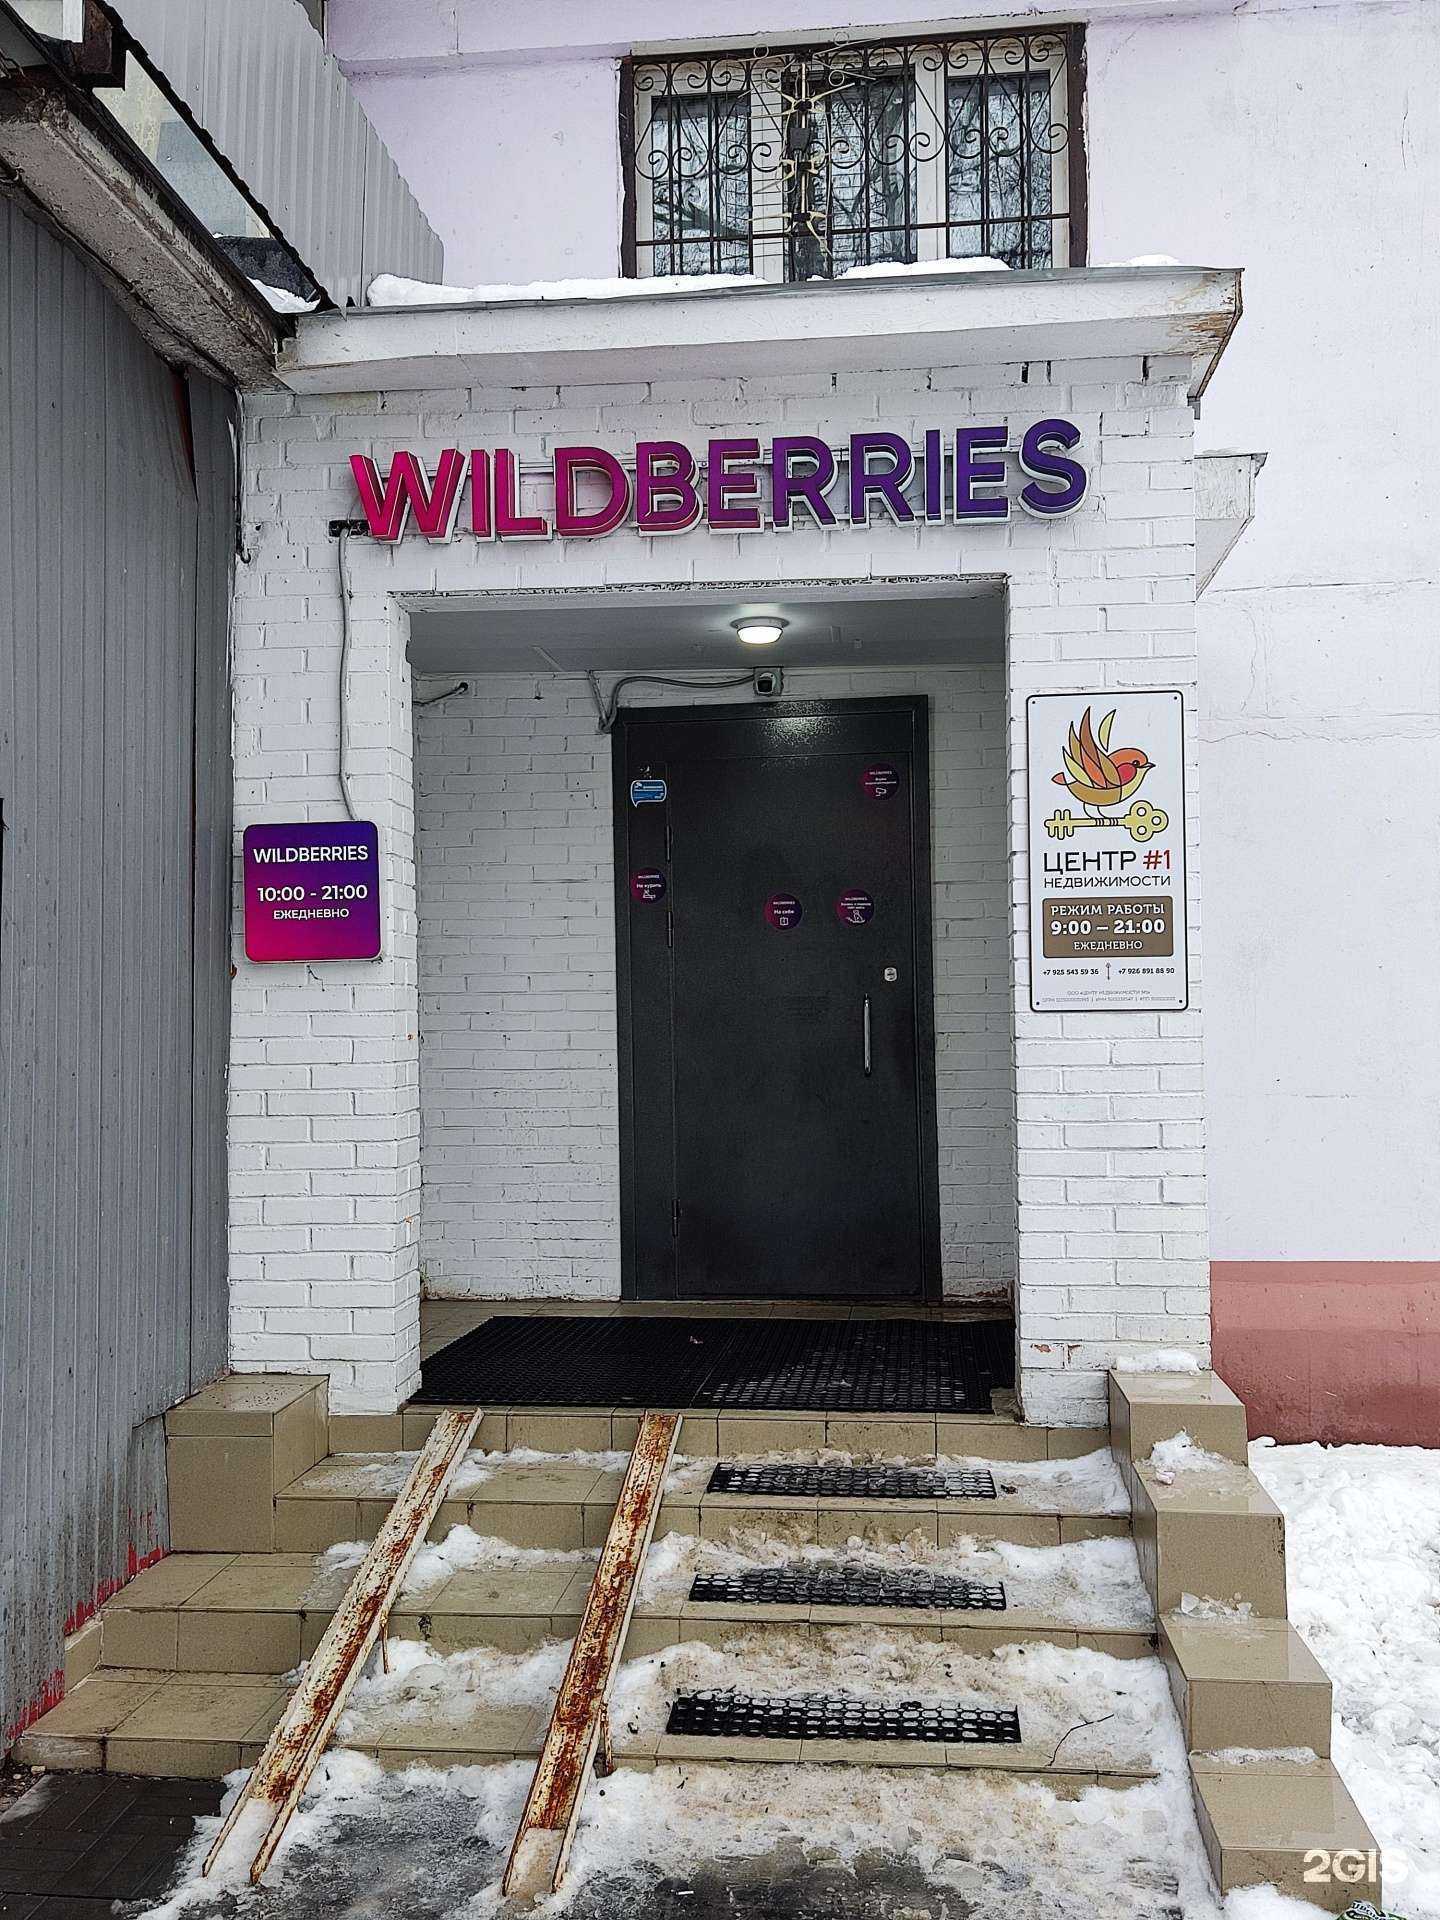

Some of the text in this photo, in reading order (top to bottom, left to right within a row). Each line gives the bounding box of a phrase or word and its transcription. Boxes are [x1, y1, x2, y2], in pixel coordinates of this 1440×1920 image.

[350, 418, 1087, 544] WILDBERRIES
[253, 846, 369, 863] WILDBERRIES
[1043, 850, 1171, 875] ЦЕНТР #1
[1044, 876, 1171, 889] НЕДВИЖИМОСТИ
[257, 886, 305, 902] 10:00
[321, 884, 368, 900] 21:00
[273, 908, 350, 920] ЕЖЕДНЕВНО
[1051, 903, 1165, 916] РЕЖИМ РАБОТЫ
[1050, 920, 1092, 935] 9:00
[1113, 919, 1165, 934] 21:00
[1074, 940, 1143, 951] ЕЖЕДНЕВНО
